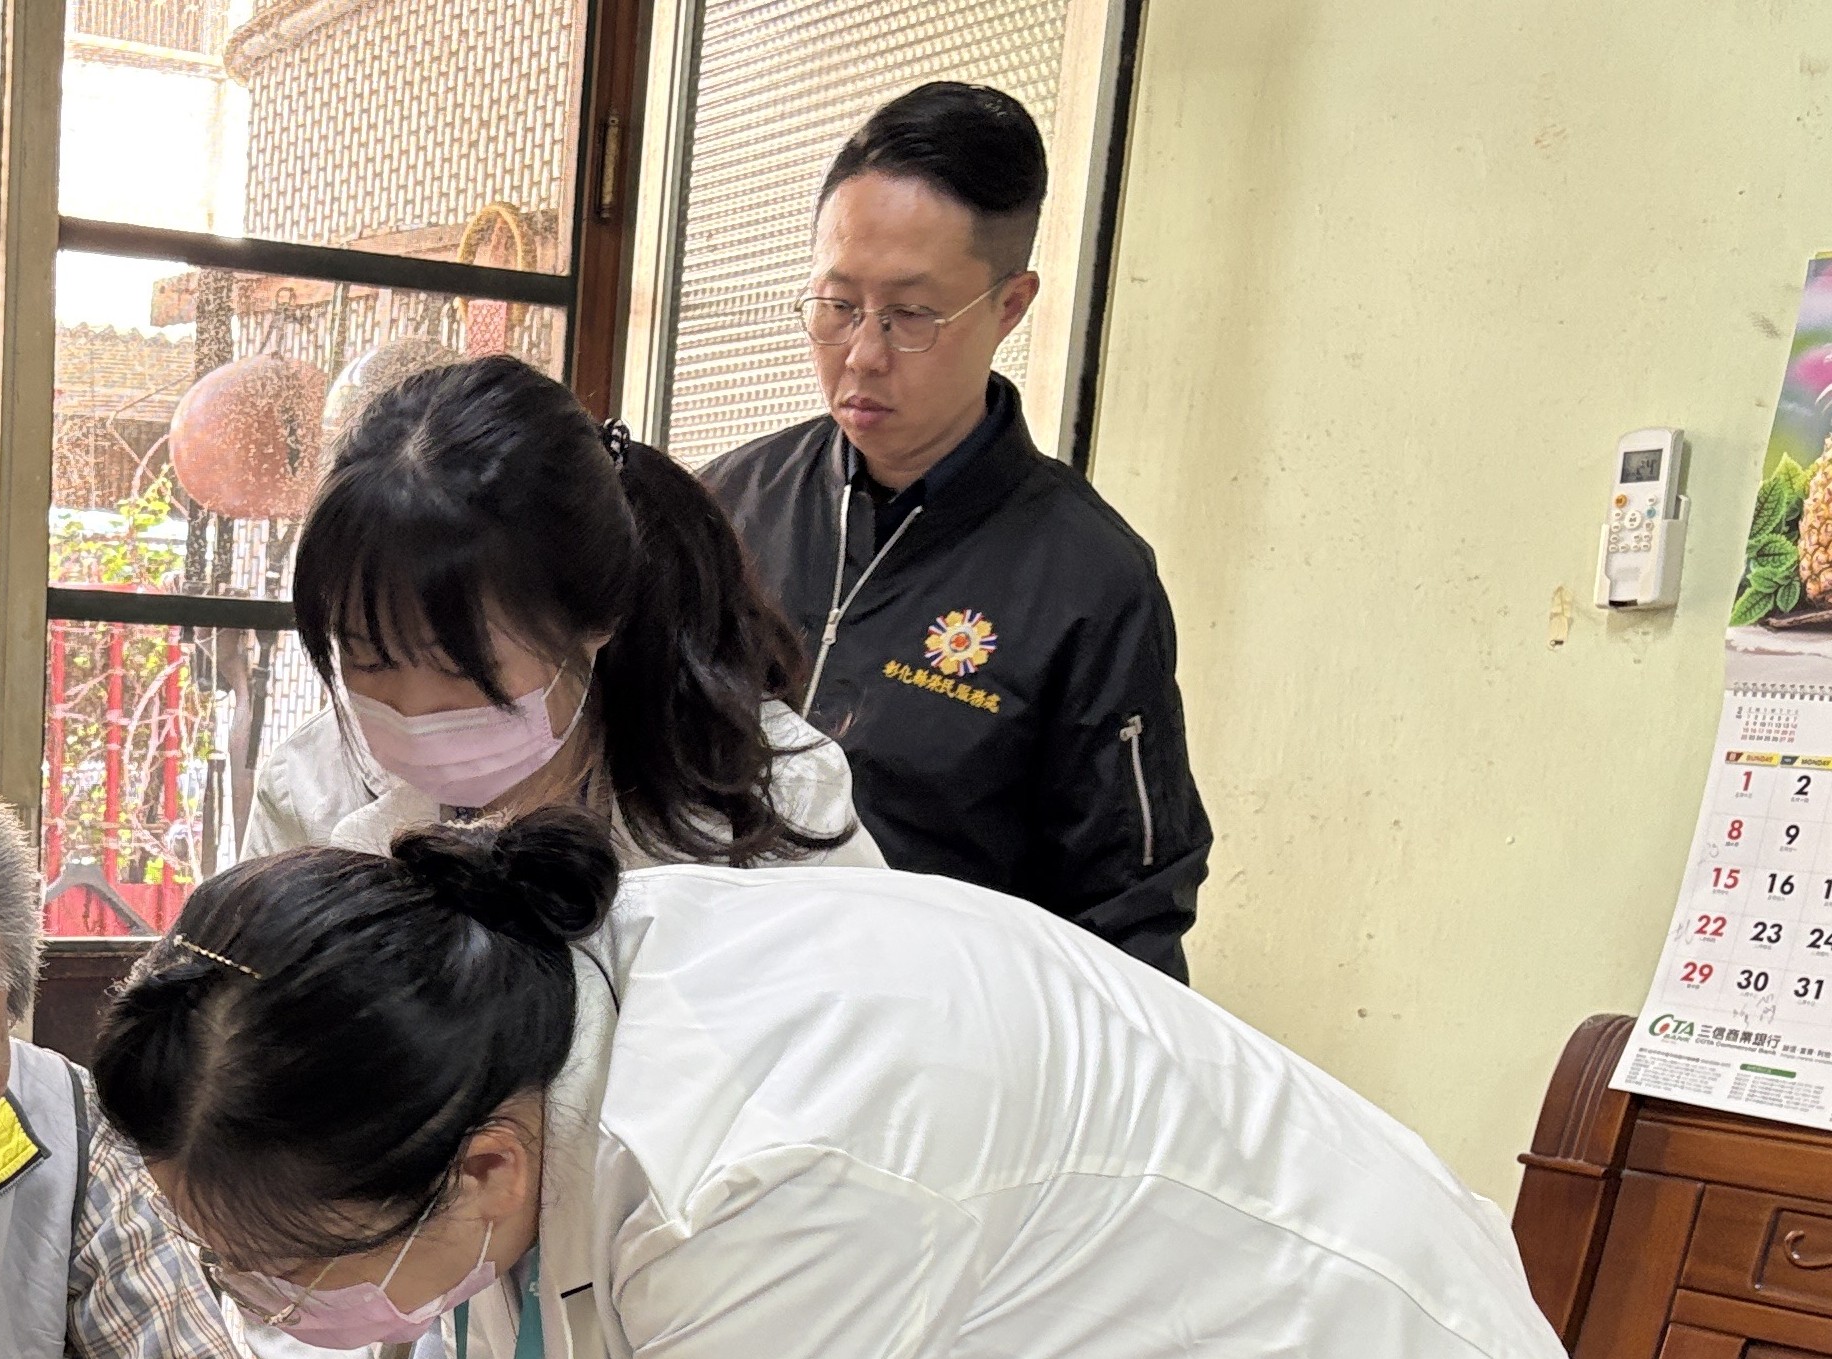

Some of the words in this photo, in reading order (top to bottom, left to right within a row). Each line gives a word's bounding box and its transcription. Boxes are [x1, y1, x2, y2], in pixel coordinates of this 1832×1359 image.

[1742, 771, 1753, 791] 1
[1794, 775, 1812, 797] 2
[1727, 819, 1744, 840] 8
[1785, 824, 1800, 845] 9
[1712, 867, 1741, 889] 15
[1768, 873, 1795, 895] 16
[1824, 879, 1832, 900] 1
[1694, 914, 1727, 937] 22
[1750, 921, 1783, 944] 23
[1680, 961, 1714, 984] 29
[1737, 969, 1769, 992] 30
[1793, 977, 1824, 1000] 31
[1698, 1024, 1782, 1049] 三信商業銀行
